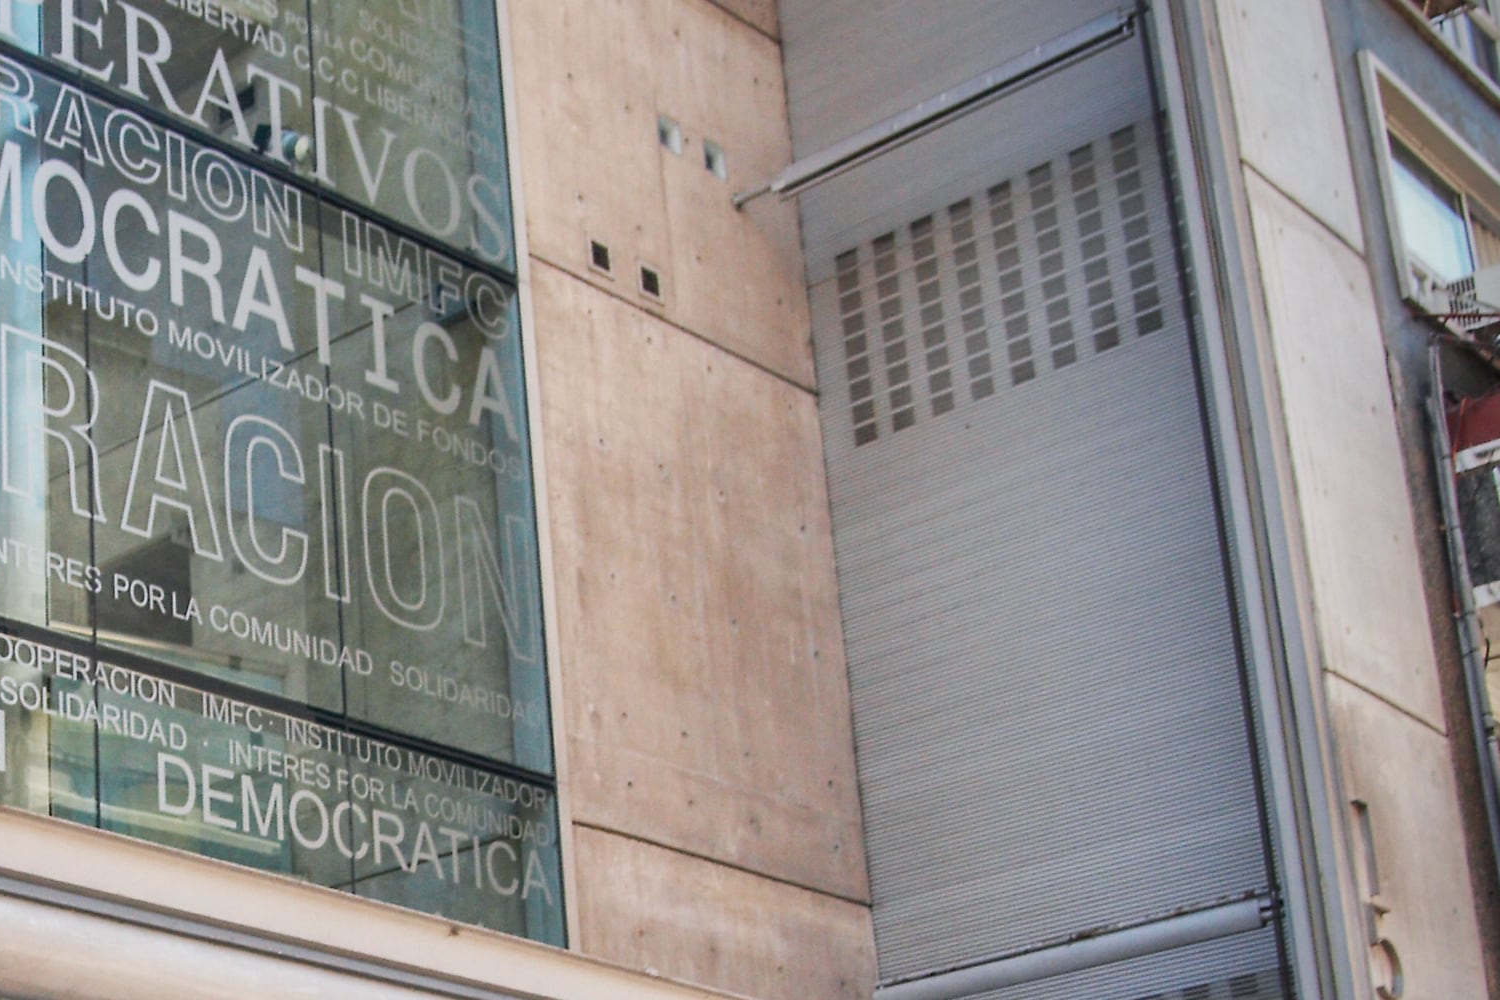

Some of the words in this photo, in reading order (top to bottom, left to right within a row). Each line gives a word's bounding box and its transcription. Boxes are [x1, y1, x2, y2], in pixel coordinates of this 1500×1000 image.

[341, 209, 510, 340] IMFC
[168, 320, 366, 421] MOVILIZADOR
[374, 402, 409, 437] DE
[417, 421, 525, 481] FONDOS
[113, 573, 167, 615] POR
[172, 592, 203, 626] LA
[210, 604, 373, 676] COMUNIDAD
[0, 677, 187, 752] SOLIDARIDAD
[228, 739, 331, 790] INTERES
[391, 782, 419, 814] LA
[424, 792, 550, 847] COMUNIDAD
[202, 692, 264, 734] IMFC
[284, 719, 402, 771] INSTITUTO
[408, 753, 551, 812] MOVILIZADOR
[157, 752, 553, 905] DEMOCRATICA
